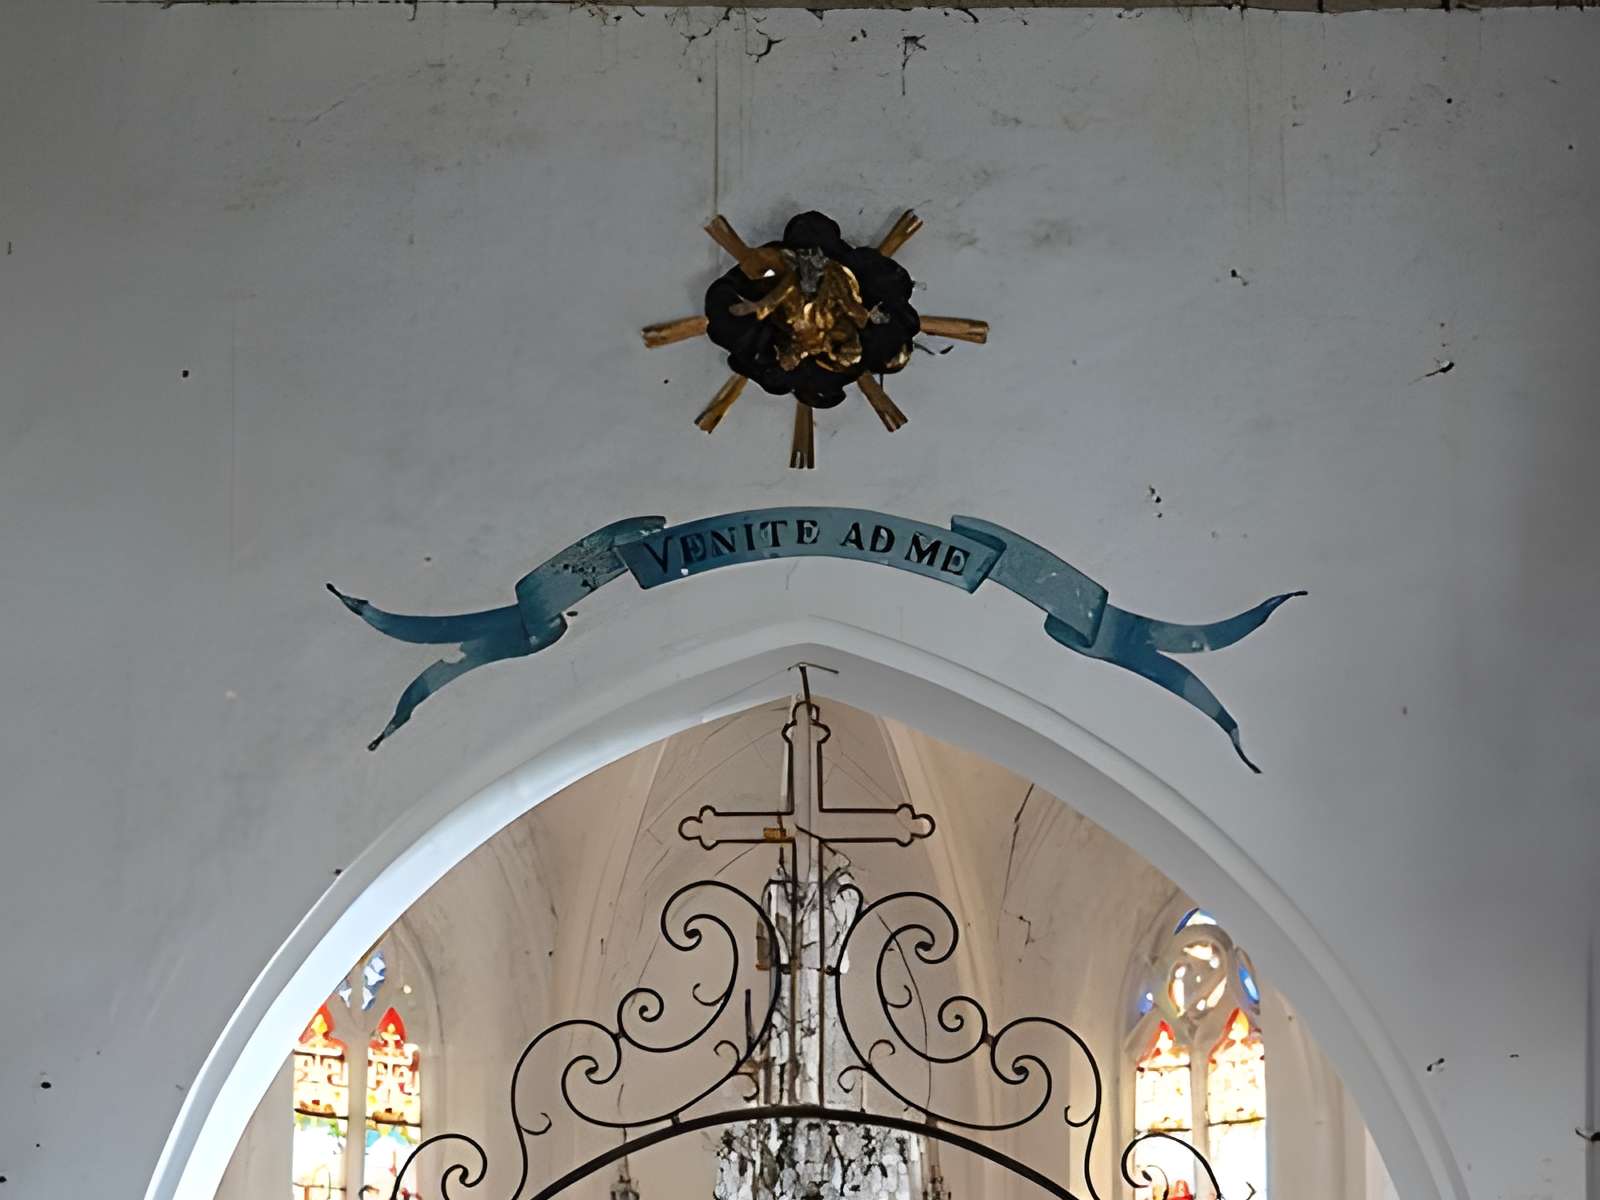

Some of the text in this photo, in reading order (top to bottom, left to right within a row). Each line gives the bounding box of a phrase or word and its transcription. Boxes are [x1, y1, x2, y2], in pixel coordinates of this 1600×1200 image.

[645, 520, 972, 576] VENITE AD ME
